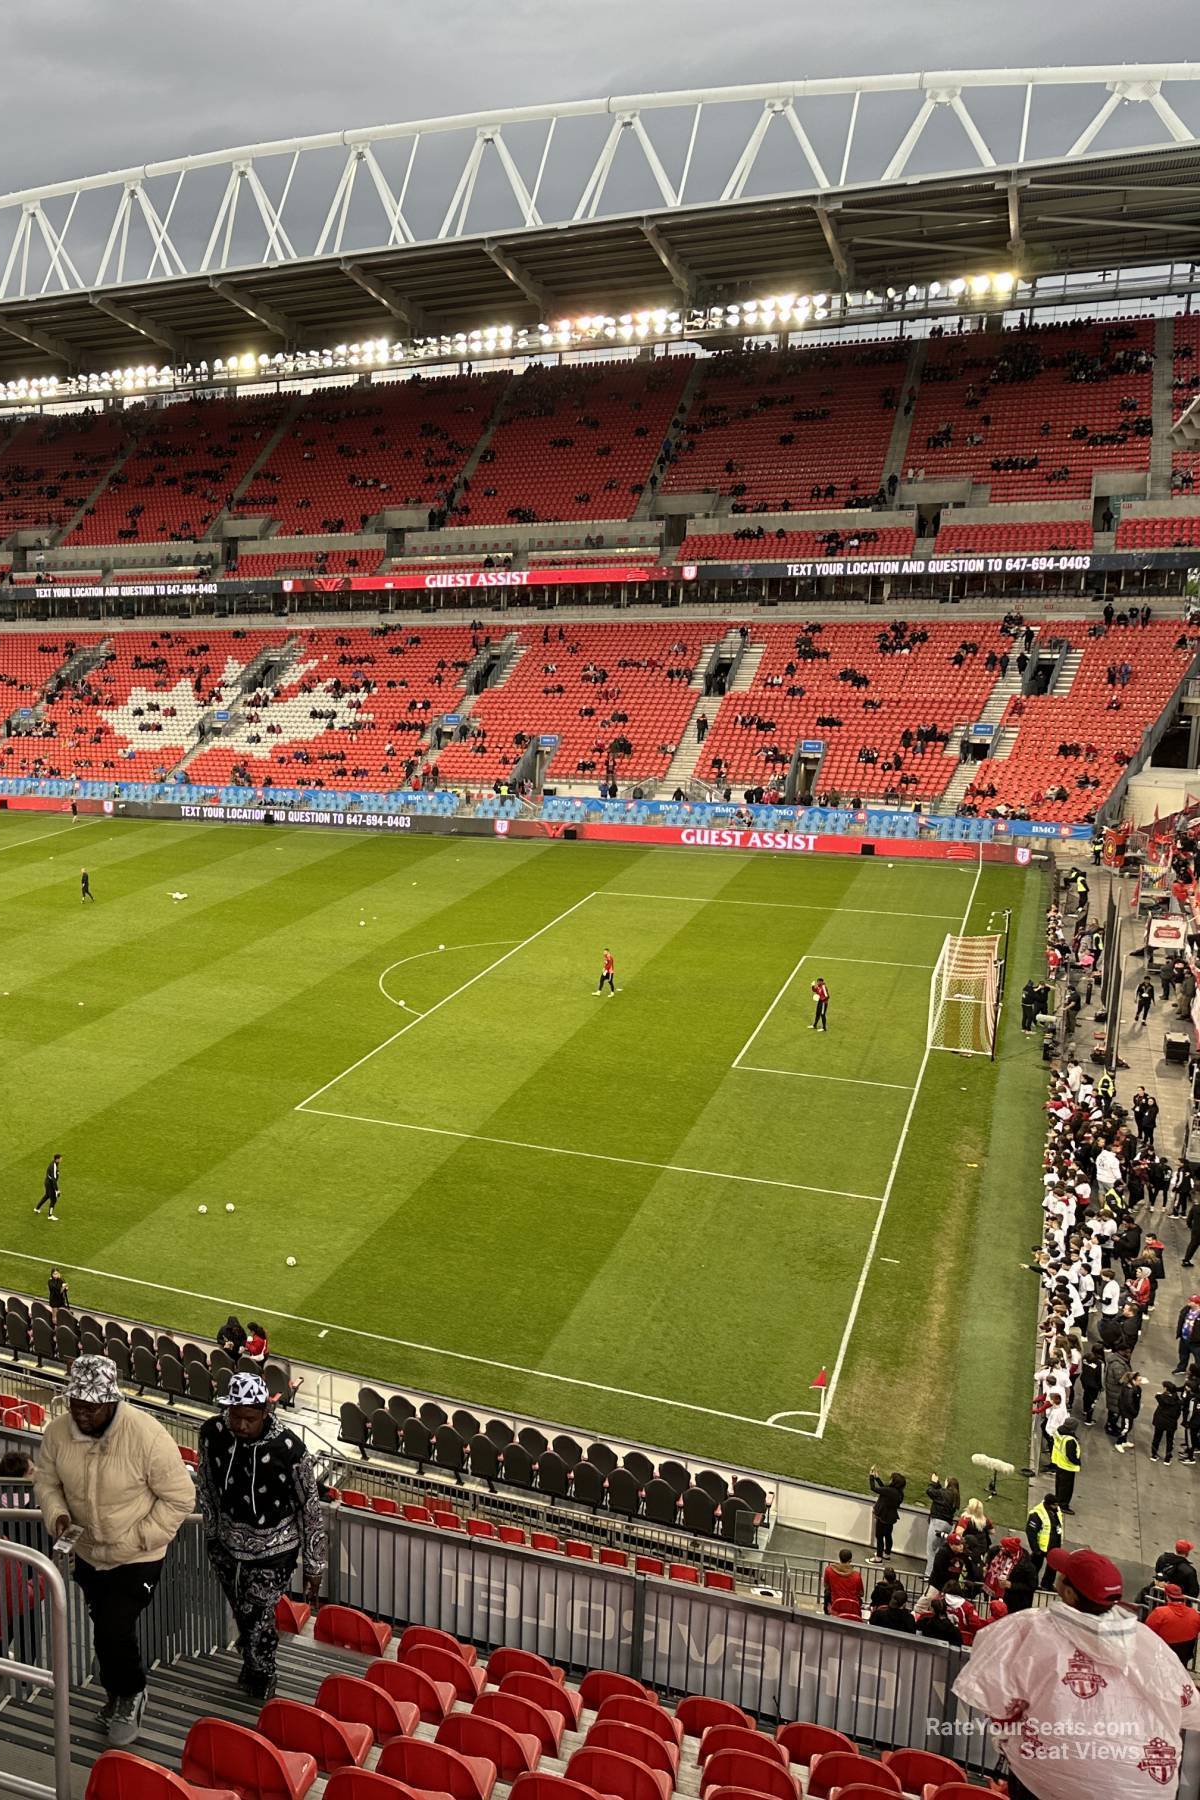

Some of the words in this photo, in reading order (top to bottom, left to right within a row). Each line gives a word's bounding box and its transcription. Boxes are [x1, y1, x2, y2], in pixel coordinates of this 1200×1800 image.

[786, 563, 812, 577] TEXT
[815, 563, 844, 576] YOUR
[846, 561, 899, 575] LOCATION
[902, 560, 925, 574] AND
[928, 559, 984, 573] QUESTION
[987, 559, 1003, 572] TO
[1005, 556, 1091, 572] 647-694-0403
[424, 573, 474, 588] GUEST
[476, 571, 530, 586] ASSIST
[35, 588, 51, 598] TEXT
[52, 587, 71, 597] YOUR
[72, 587, 102, 598] LOCATION
[104, 587, 120, 597] AND
[121, 586, 154, 597] QUESTION
[155, 585, 165, 595] TO
[166, 583, 218, 595] 647-694-0403
[181, 805, 201, 817] TEXT
[202, 807, 225, 819] YOUR
[226, 808, 265, 821] LOCATION
[288, 811, 330, 824] QUESTION
[333, 813, 344, 825] TO
[346, 814, 411, 828] 647-694-0403
[715, 806, 736, 815] BMO
[1031, 825, 1056, 834] BMO
[681, 828, 746, 847] GUEST
[748, 831, 818, 851] ASSIST
